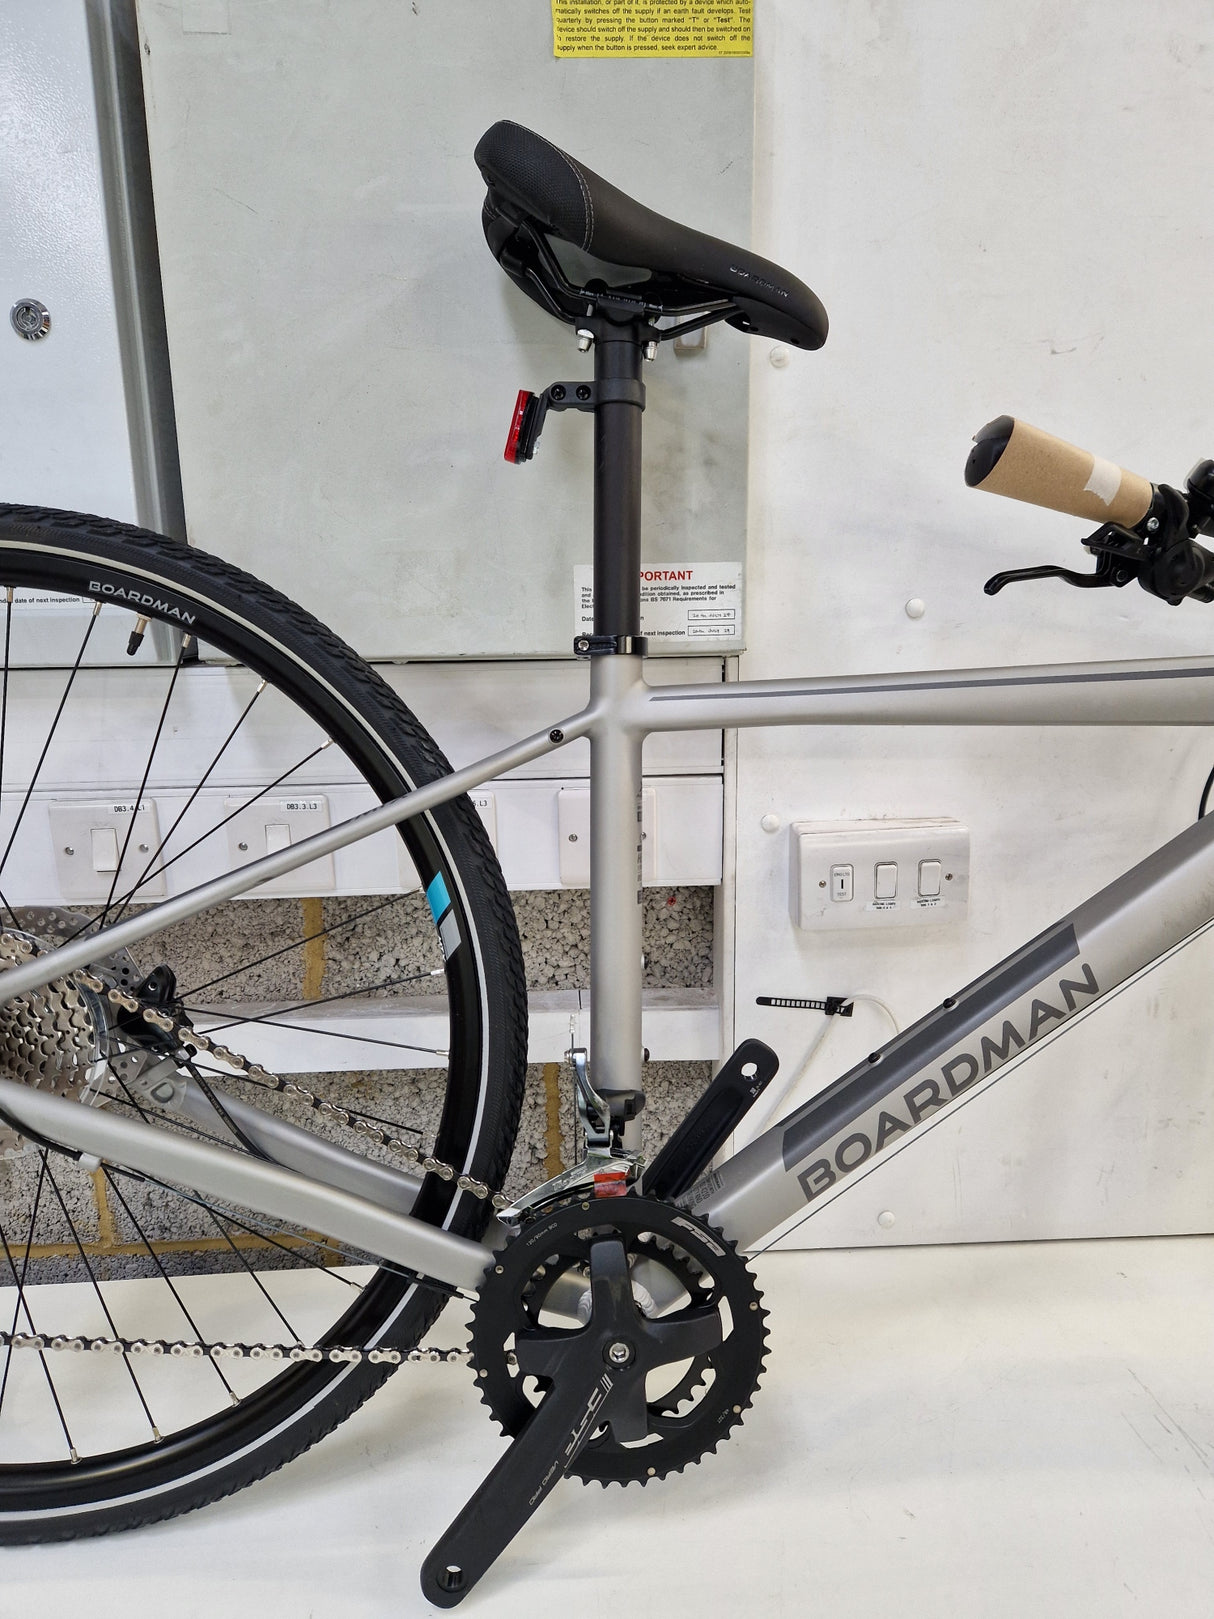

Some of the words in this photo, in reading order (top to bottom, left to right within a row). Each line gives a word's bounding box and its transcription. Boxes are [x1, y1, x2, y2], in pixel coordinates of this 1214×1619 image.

[640, 570, 693, 581] PORTANT
[89, 580, 196, 624] BOARDMAN
[798, 963, 1100, 1203] BOARDMAN
